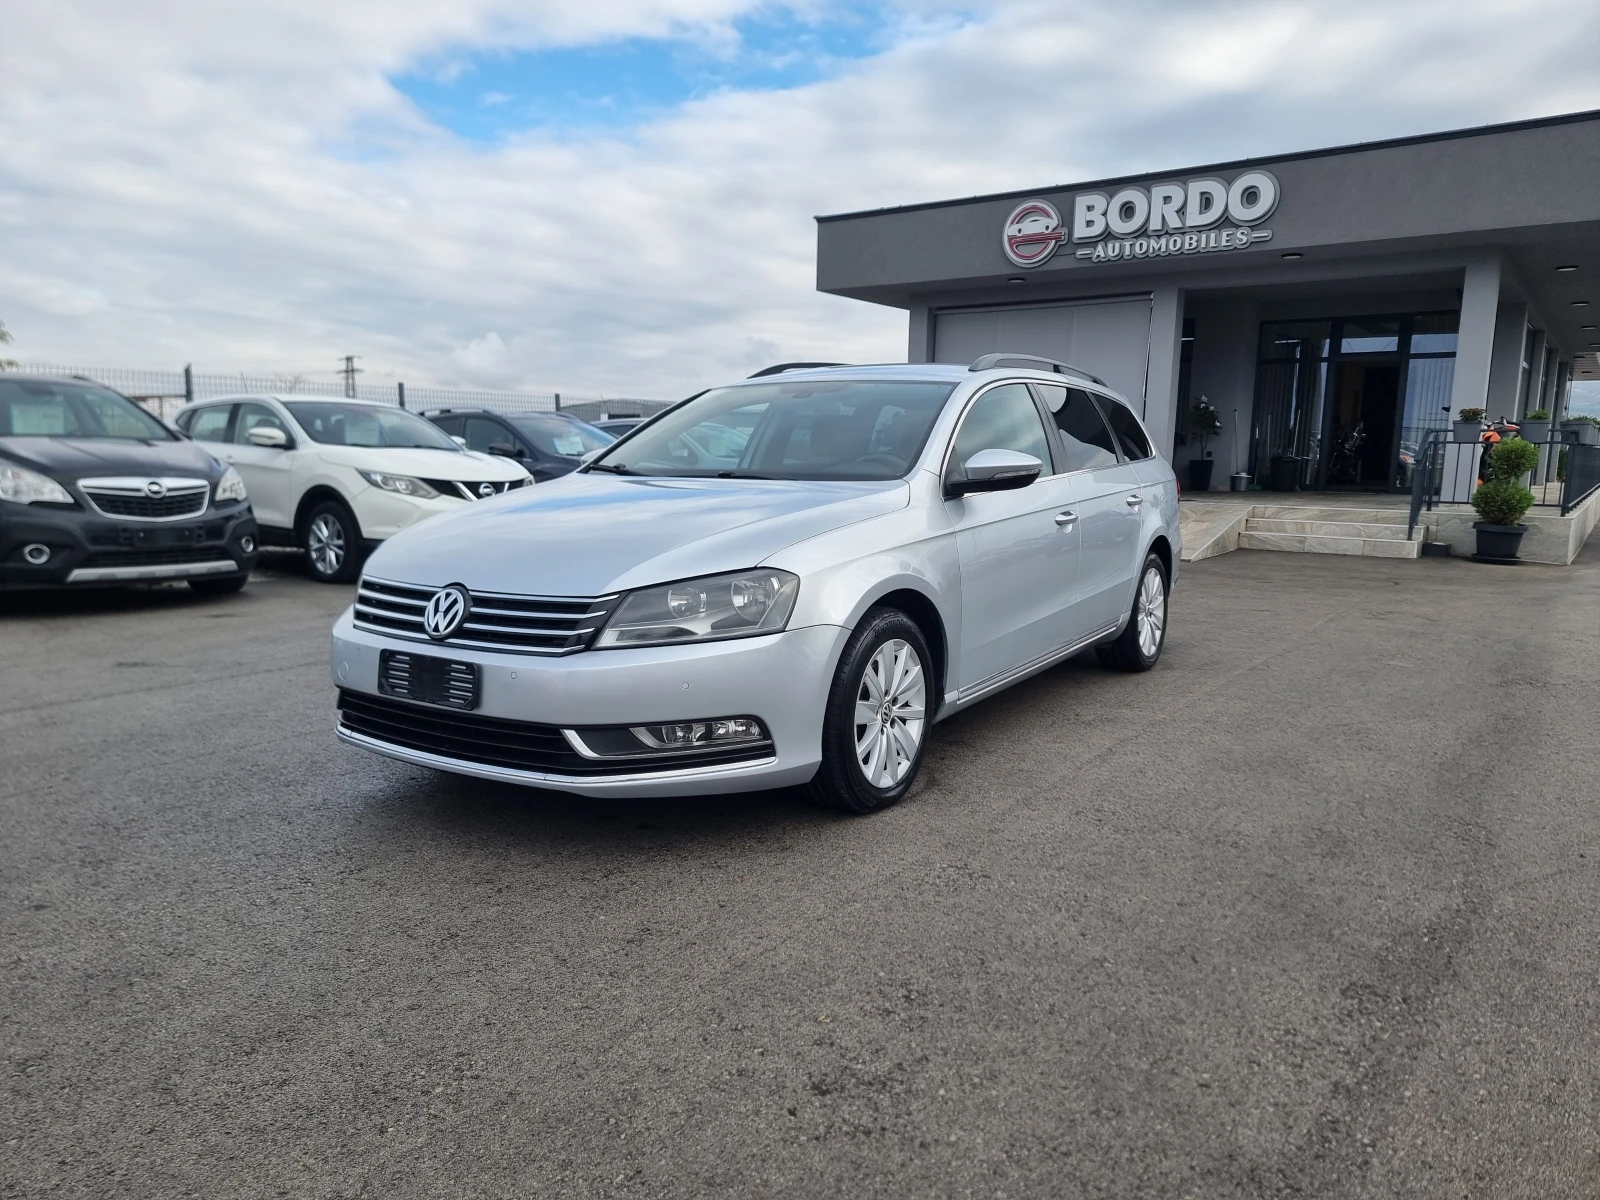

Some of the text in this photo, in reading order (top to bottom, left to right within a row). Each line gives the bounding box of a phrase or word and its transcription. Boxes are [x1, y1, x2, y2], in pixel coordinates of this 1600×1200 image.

[1073, 173, 1276, 239] BORDO
[1093, 229, 1249, 259] AUTOMOBILES
[425, 589, 464, 637] VW
